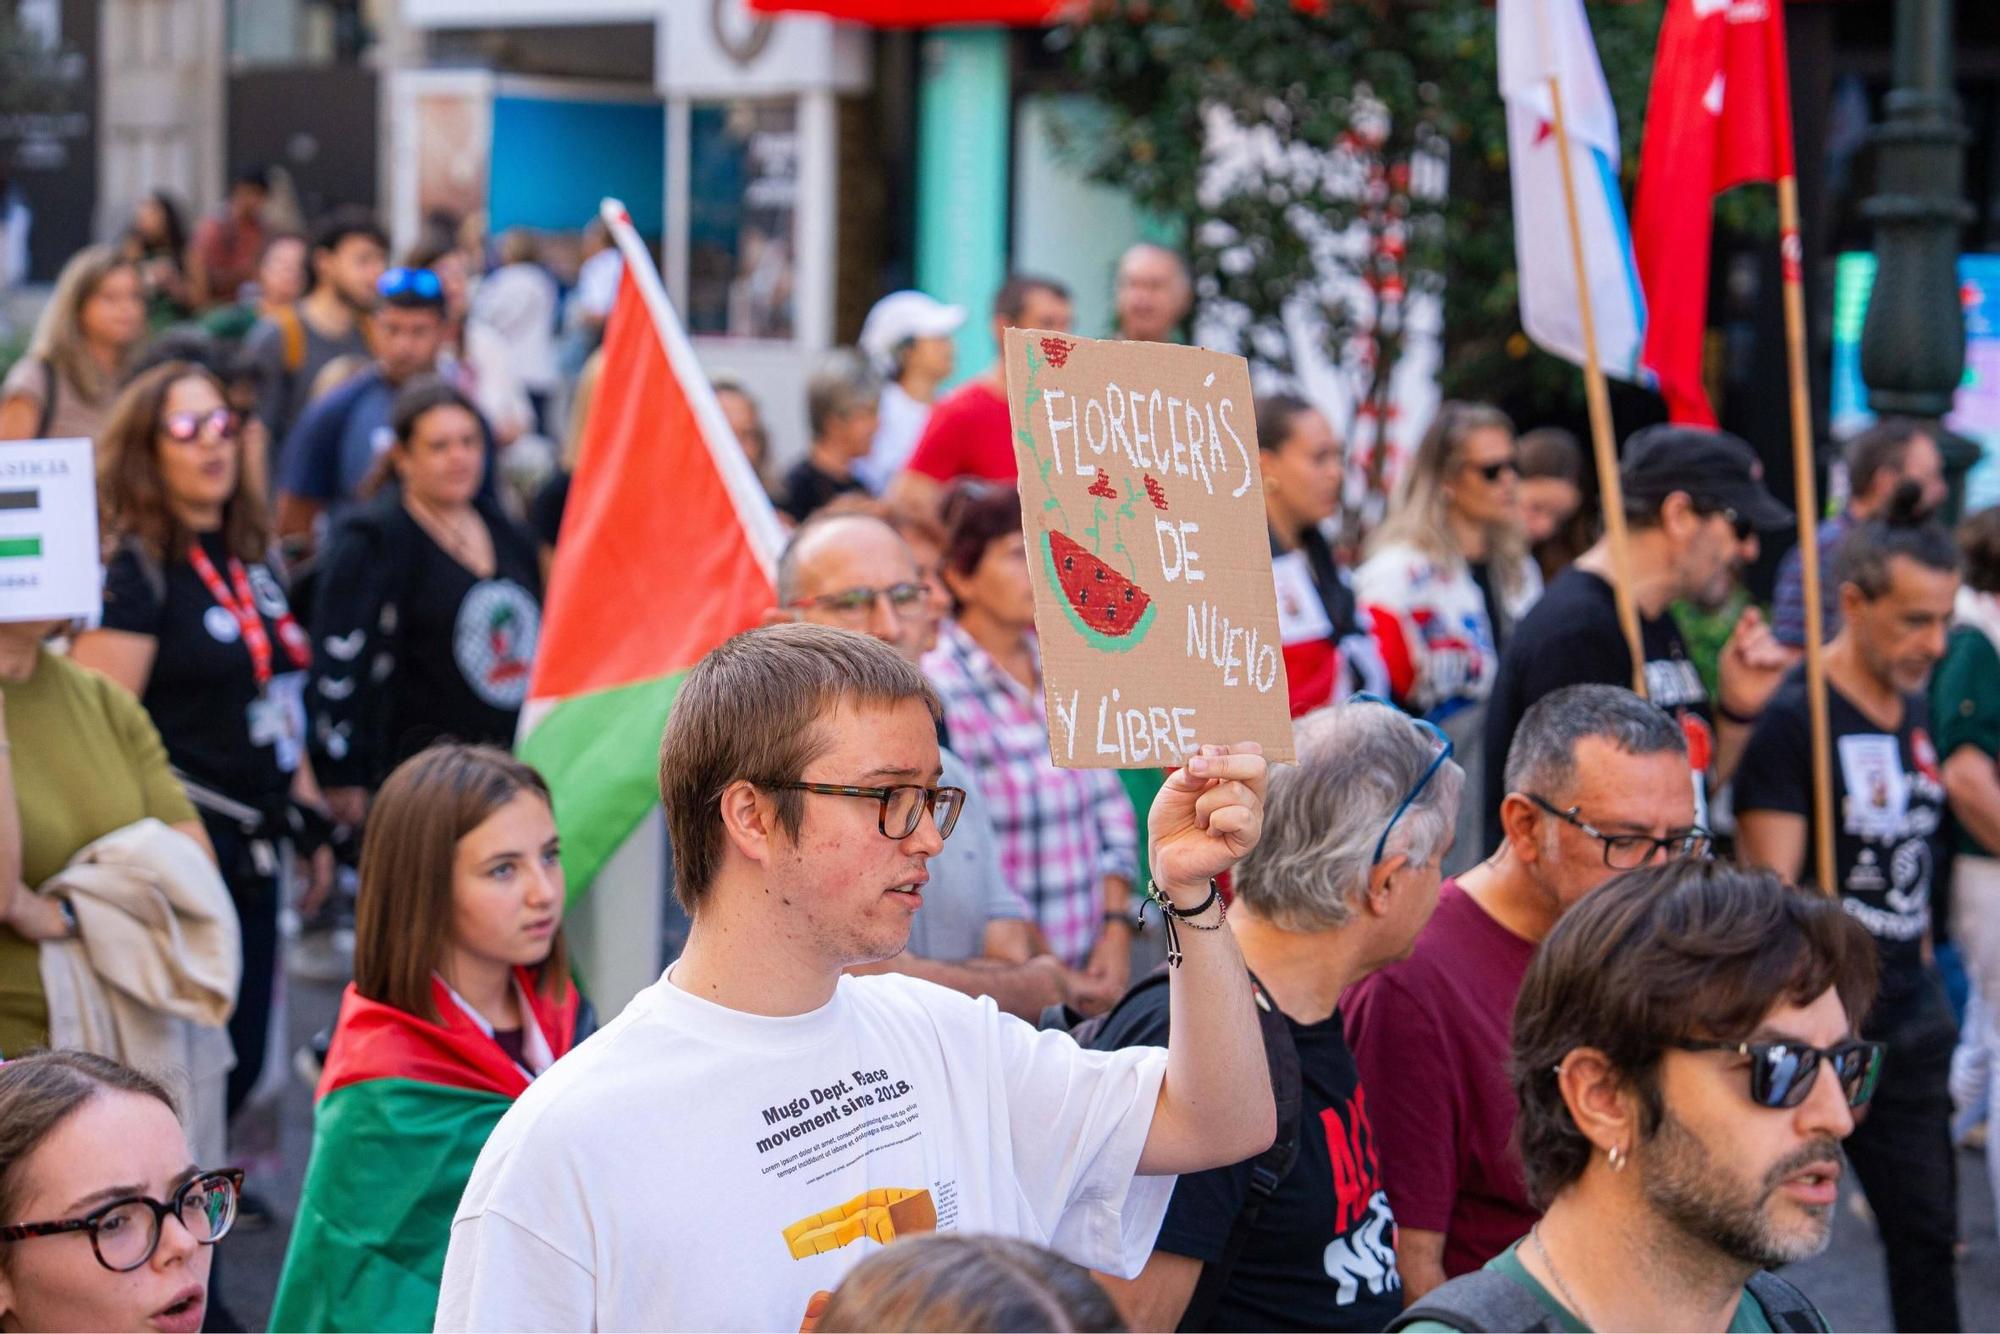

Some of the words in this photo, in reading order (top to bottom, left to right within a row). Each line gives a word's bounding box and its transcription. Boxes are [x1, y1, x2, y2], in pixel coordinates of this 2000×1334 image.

[1044, 372, 1251, 497] FLORECERÁS
[1154, 514, 1206, 584] DE
[1186, 600, 1277, 693] NUEVO
[1056, 690, 1079, 760] Y
[756, 1105, 841, 1153] movement
[762, 1098, 810, 1126] Mugo
[810, 1080, 853, 1104] Dept.
[761, 1162, 780, 1175] Lorem
[780, 1153, 798, 1167] ipsum
[799, 1147, 813, 1158] dolor
[777, 1165, 798, 1179] tempor
